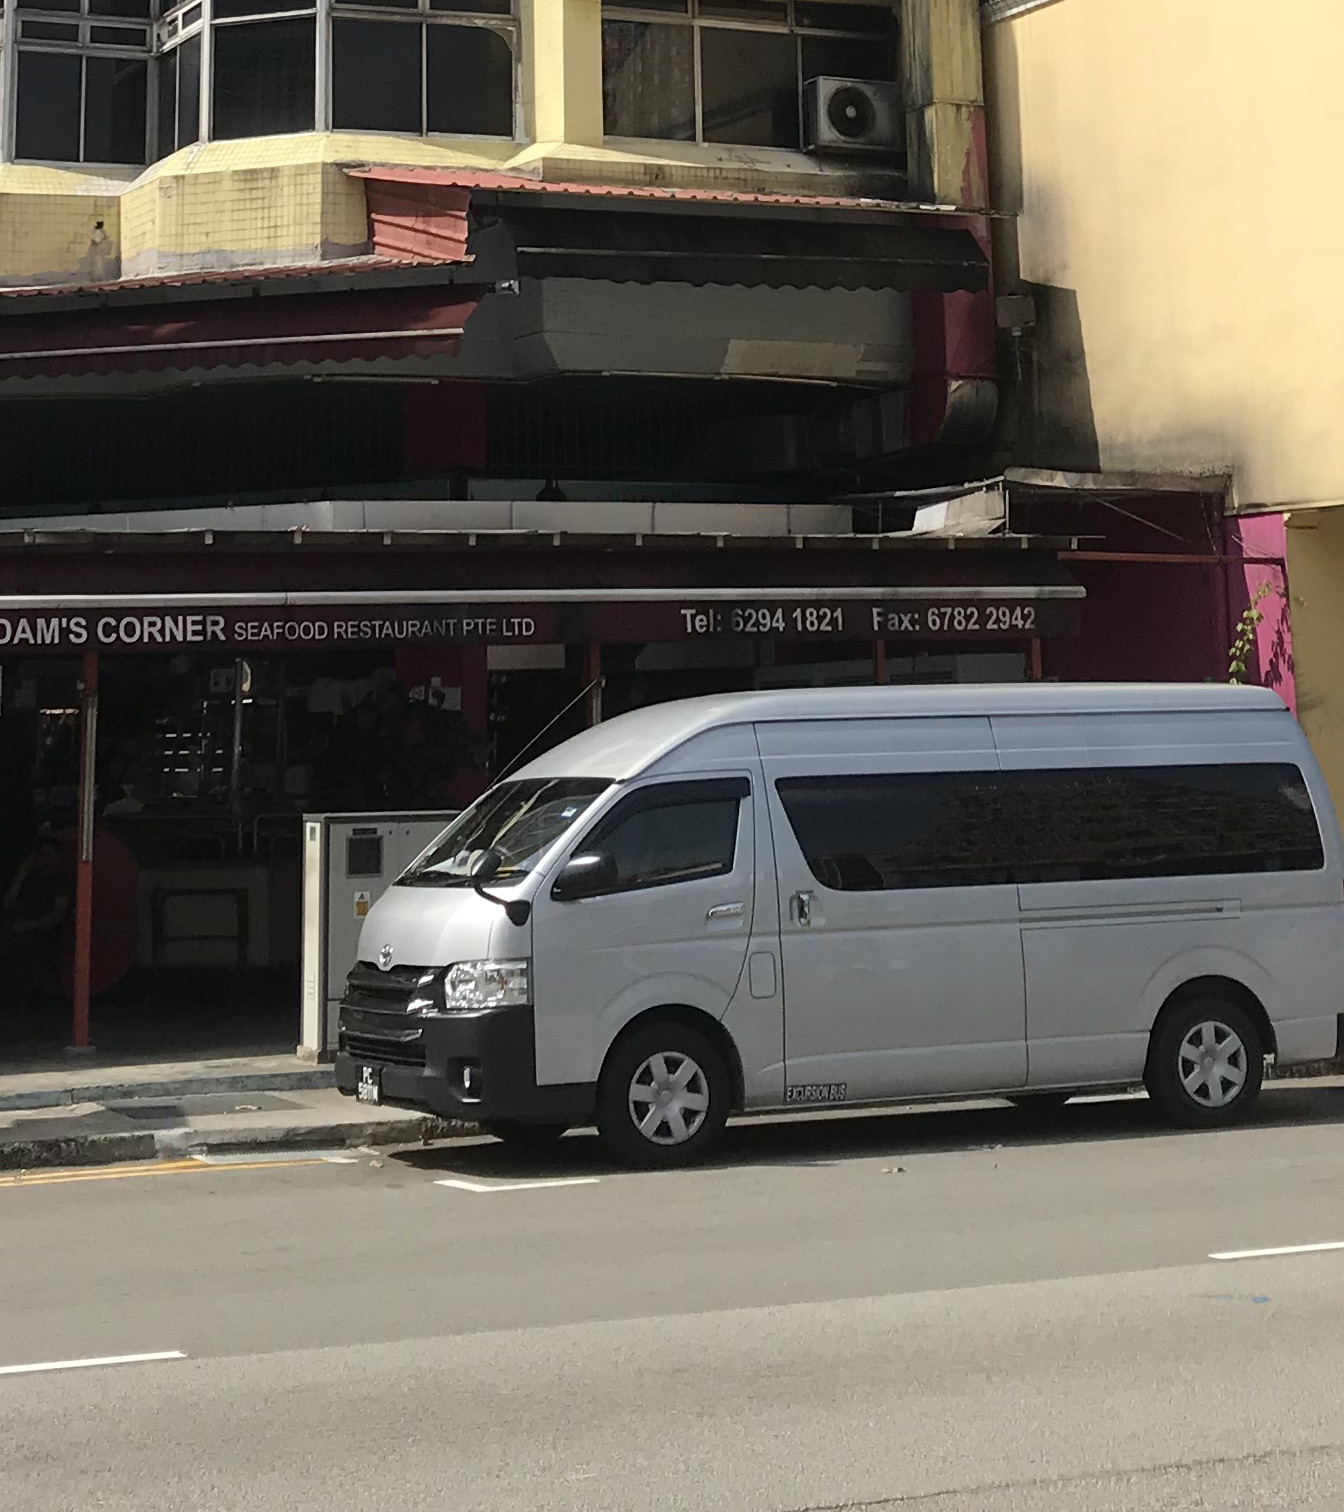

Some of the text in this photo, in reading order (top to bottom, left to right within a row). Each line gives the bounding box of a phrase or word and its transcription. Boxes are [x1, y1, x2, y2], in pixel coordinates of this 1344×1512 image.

[97, 614, 226, 644] CORNER
[233, 620, 329, 641] SEAFOOD
[331, 618, 458, 640] RESTAURANT
[462, 618, 498, 637] PTE
[502, 618, 536, 637] LTD
[681, 605, 1037, 634] Tel: 6294 1821 Fax: 6782 2942
[362, 1066, 374, 1084] PC
[786, 1084, 846, 1102] EXCURSION BUS
